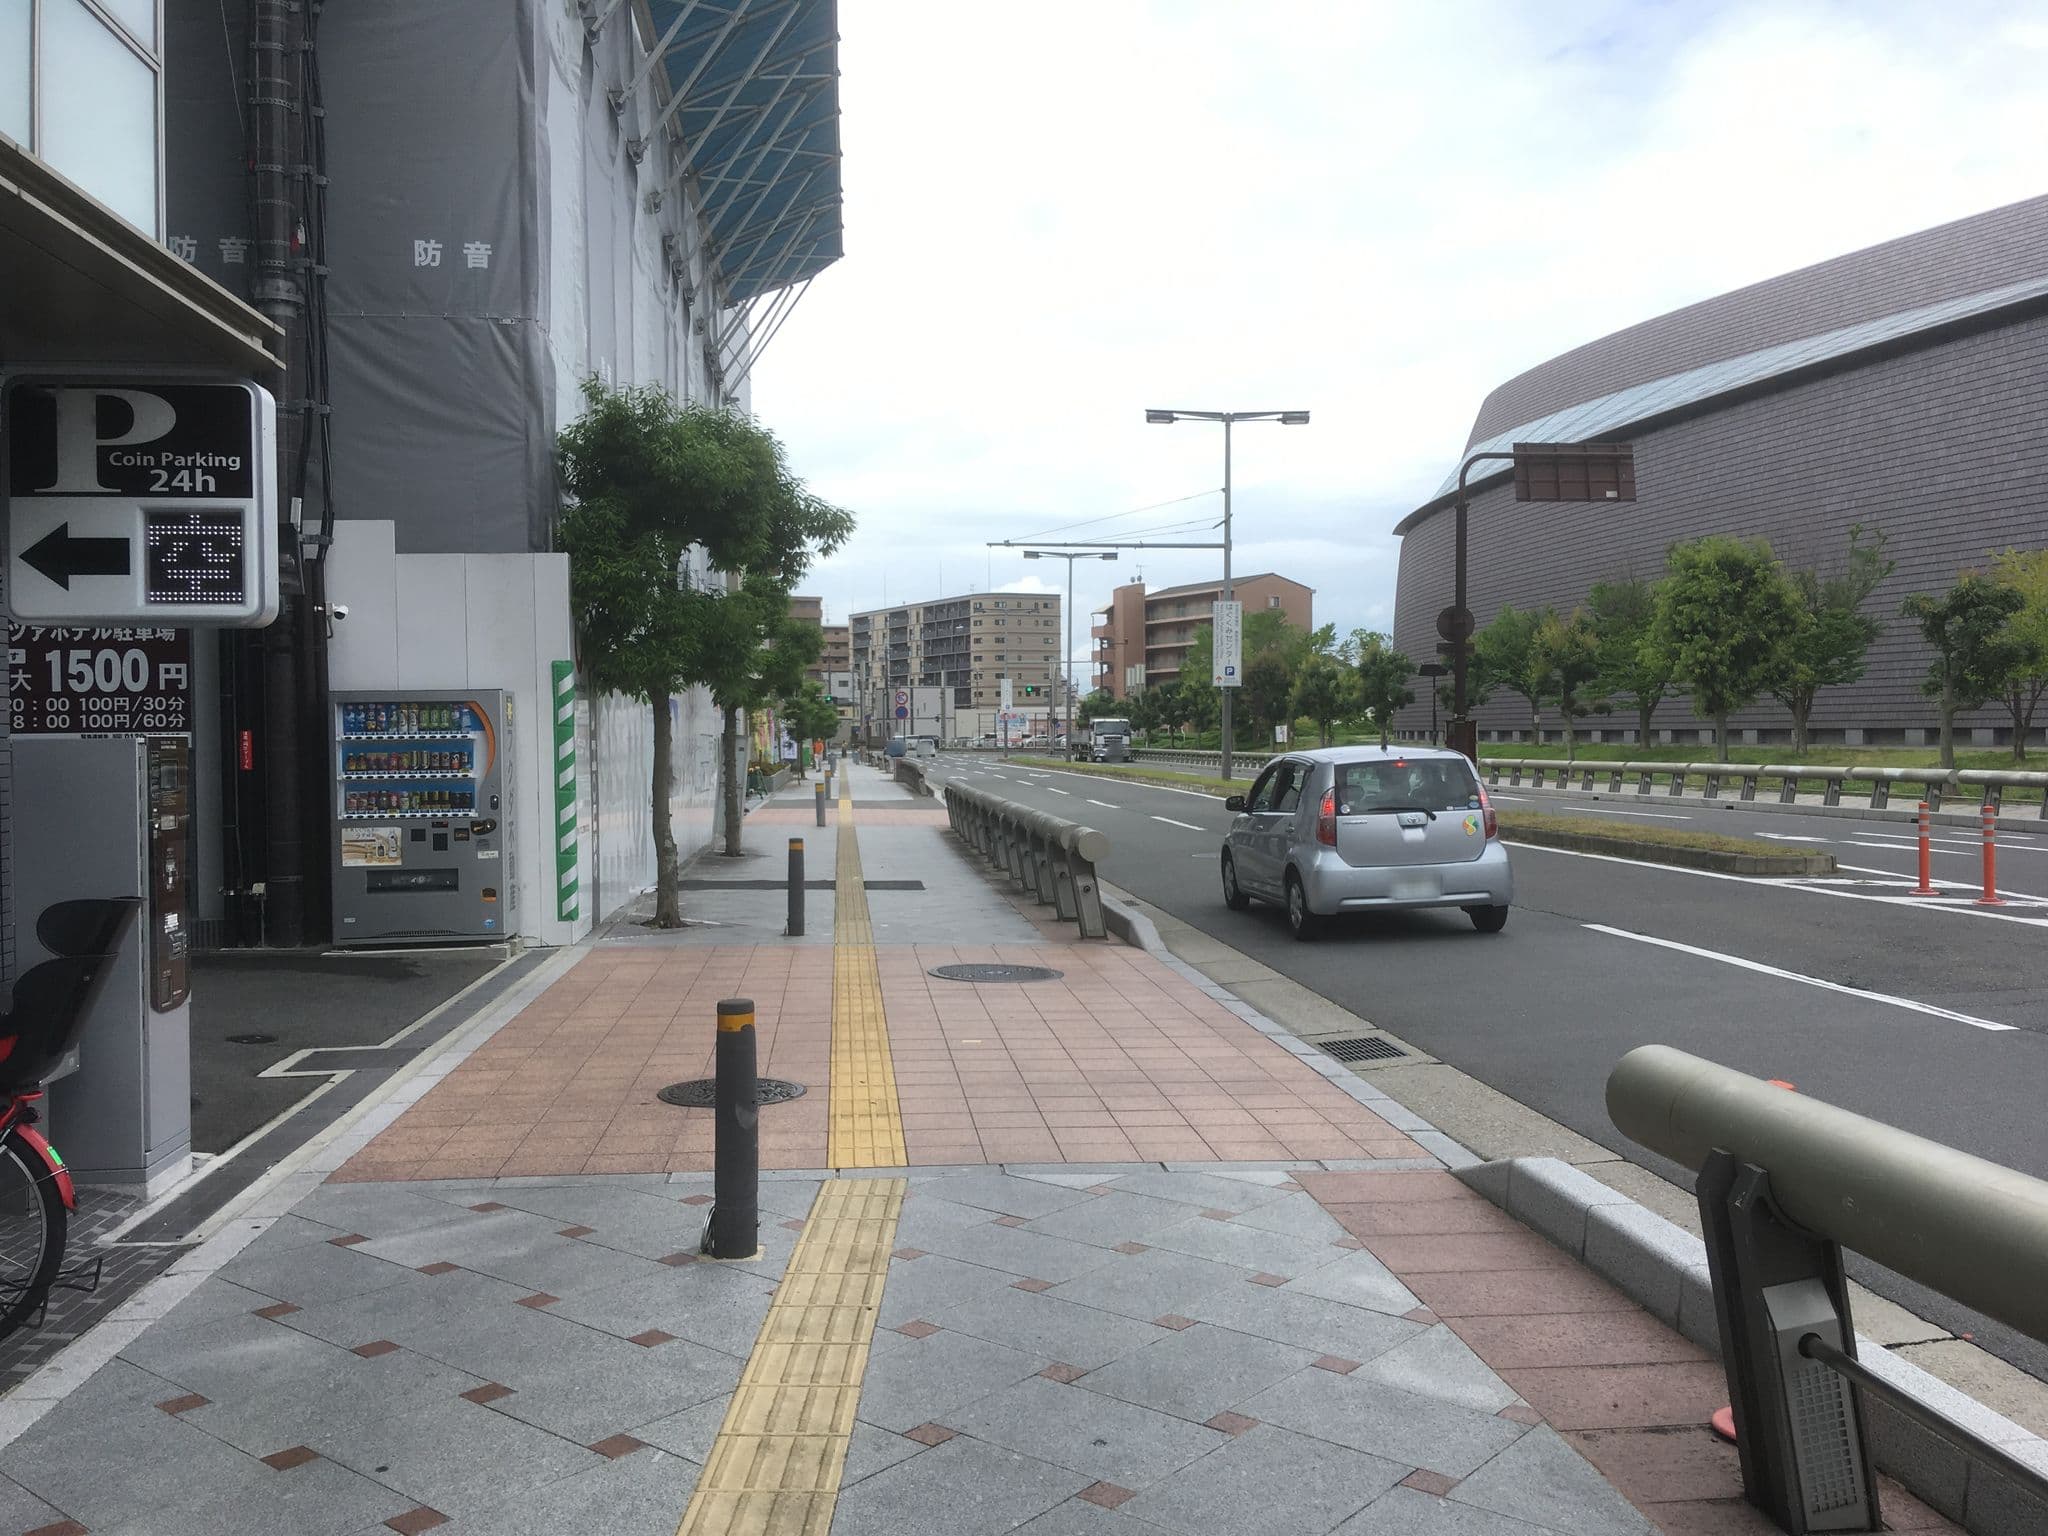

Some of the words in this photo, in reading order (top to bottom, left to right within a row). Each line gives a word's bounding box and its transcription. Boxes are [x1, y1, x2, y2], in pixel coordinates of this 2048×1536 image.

[34, 388, 177, 493] P
[109, 452, 155, 467] Coin
[161, 452, 241, 471] Parking
[149, 469, 216, 492] 24h
[149, 513, 243, 602] 空
[80, 697, 185, 711] 100円/30分
[80, 714, 186, 728] 100円/60分
